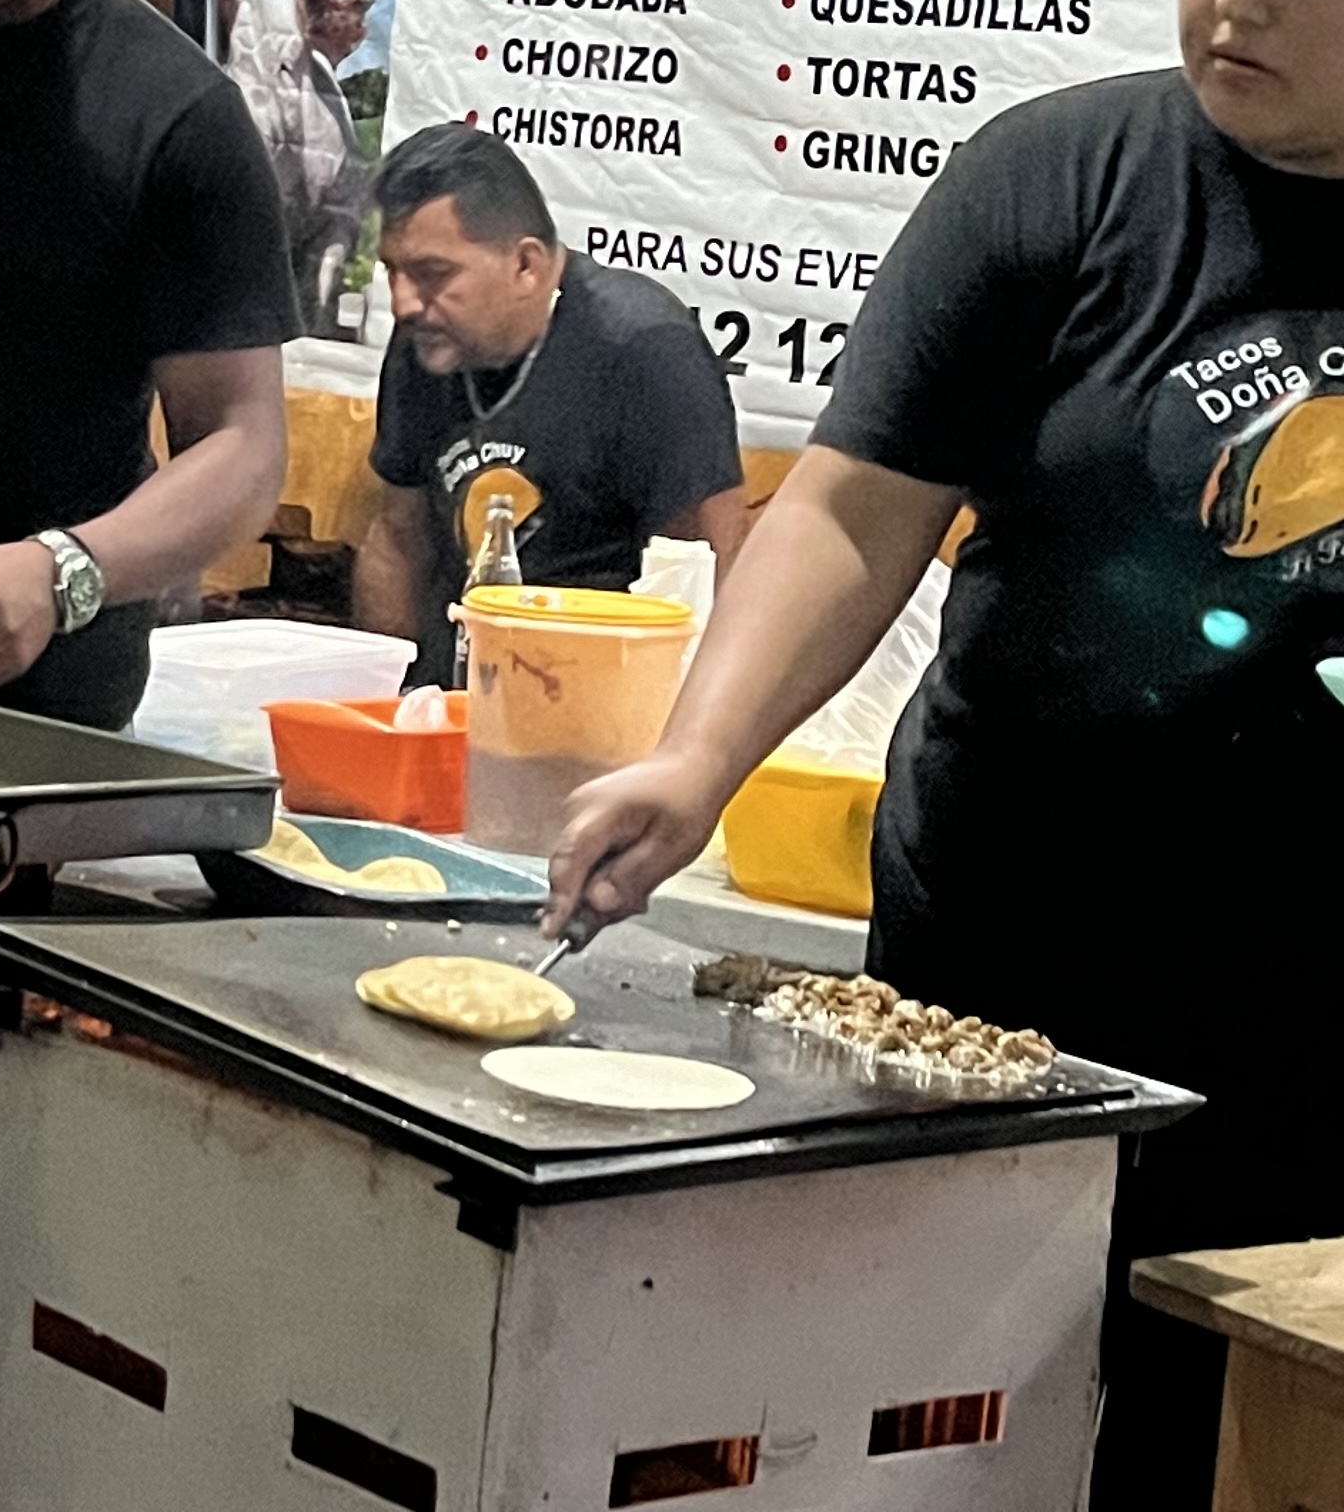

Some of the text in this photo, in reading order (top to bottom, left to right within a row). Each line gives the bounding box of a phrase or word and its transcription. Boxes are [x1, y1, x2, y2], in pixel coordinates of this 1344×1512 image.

[502, 38, 678, 84] CHORIZO
[807, 56, 977, 104] TORTAS
[492, 106, 683, 156] CHISTORRA
[803, 131, 963, 177] GRING
[587, 227, 688, 274] PARA
[700, 237, 782, 283] SUS
[690, 306, 751, 377] 2
[1170, 336, 1283, 391] Tacos
[1197, 361, 1311, 425] Doña
